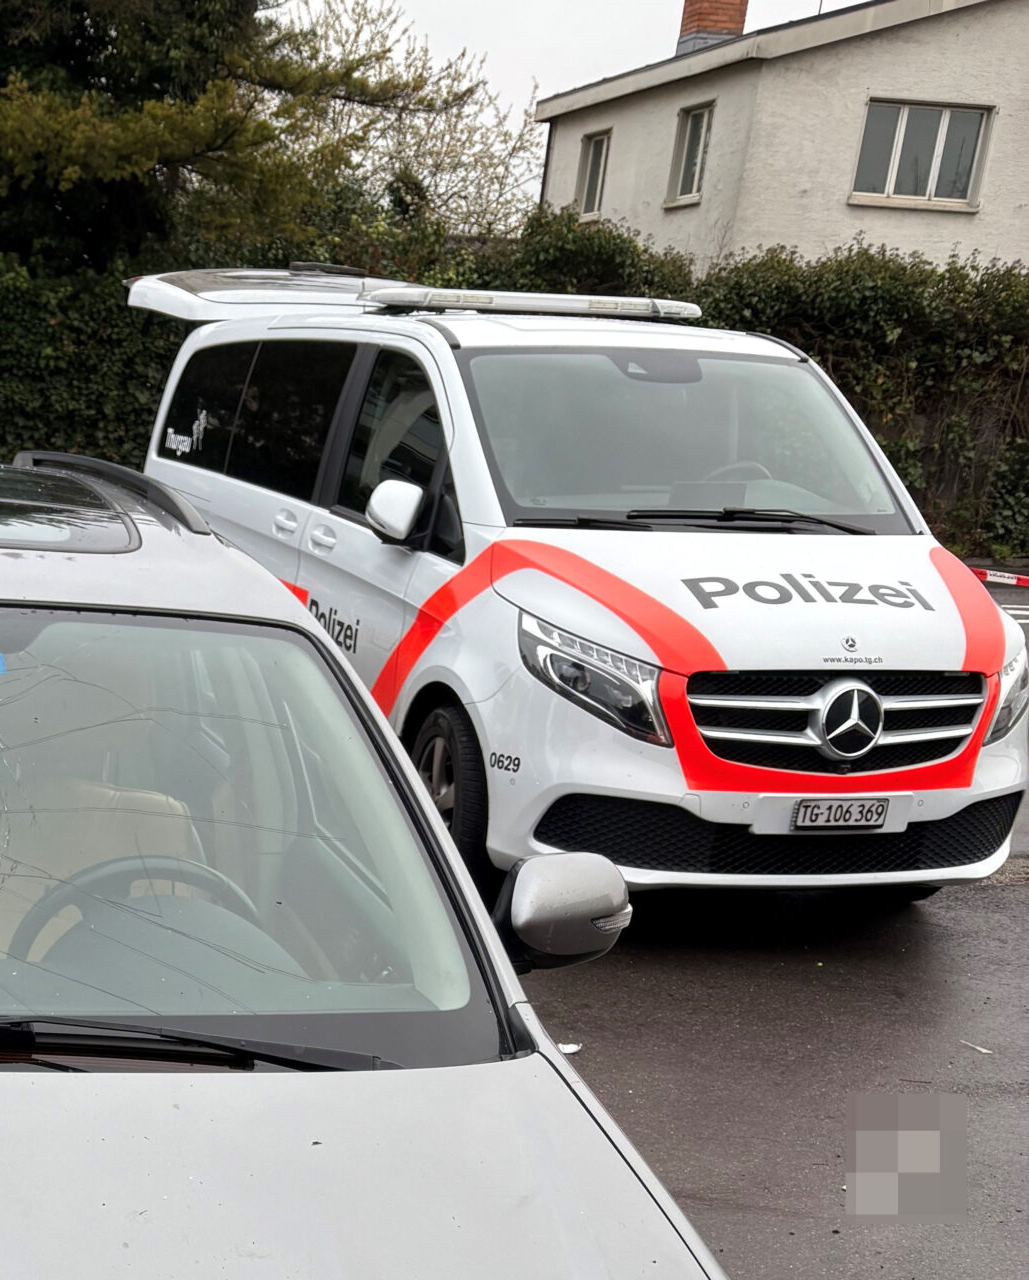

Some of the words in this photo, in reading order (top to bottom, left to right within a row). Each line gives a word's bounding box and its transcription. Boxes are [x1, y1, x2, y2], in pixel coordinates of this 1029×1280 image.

[680, 572, 936, 612] Polizei
[822, 656, 884, 665] www.kapo.tg.ch
[489, 751, 521, 773] 0629
